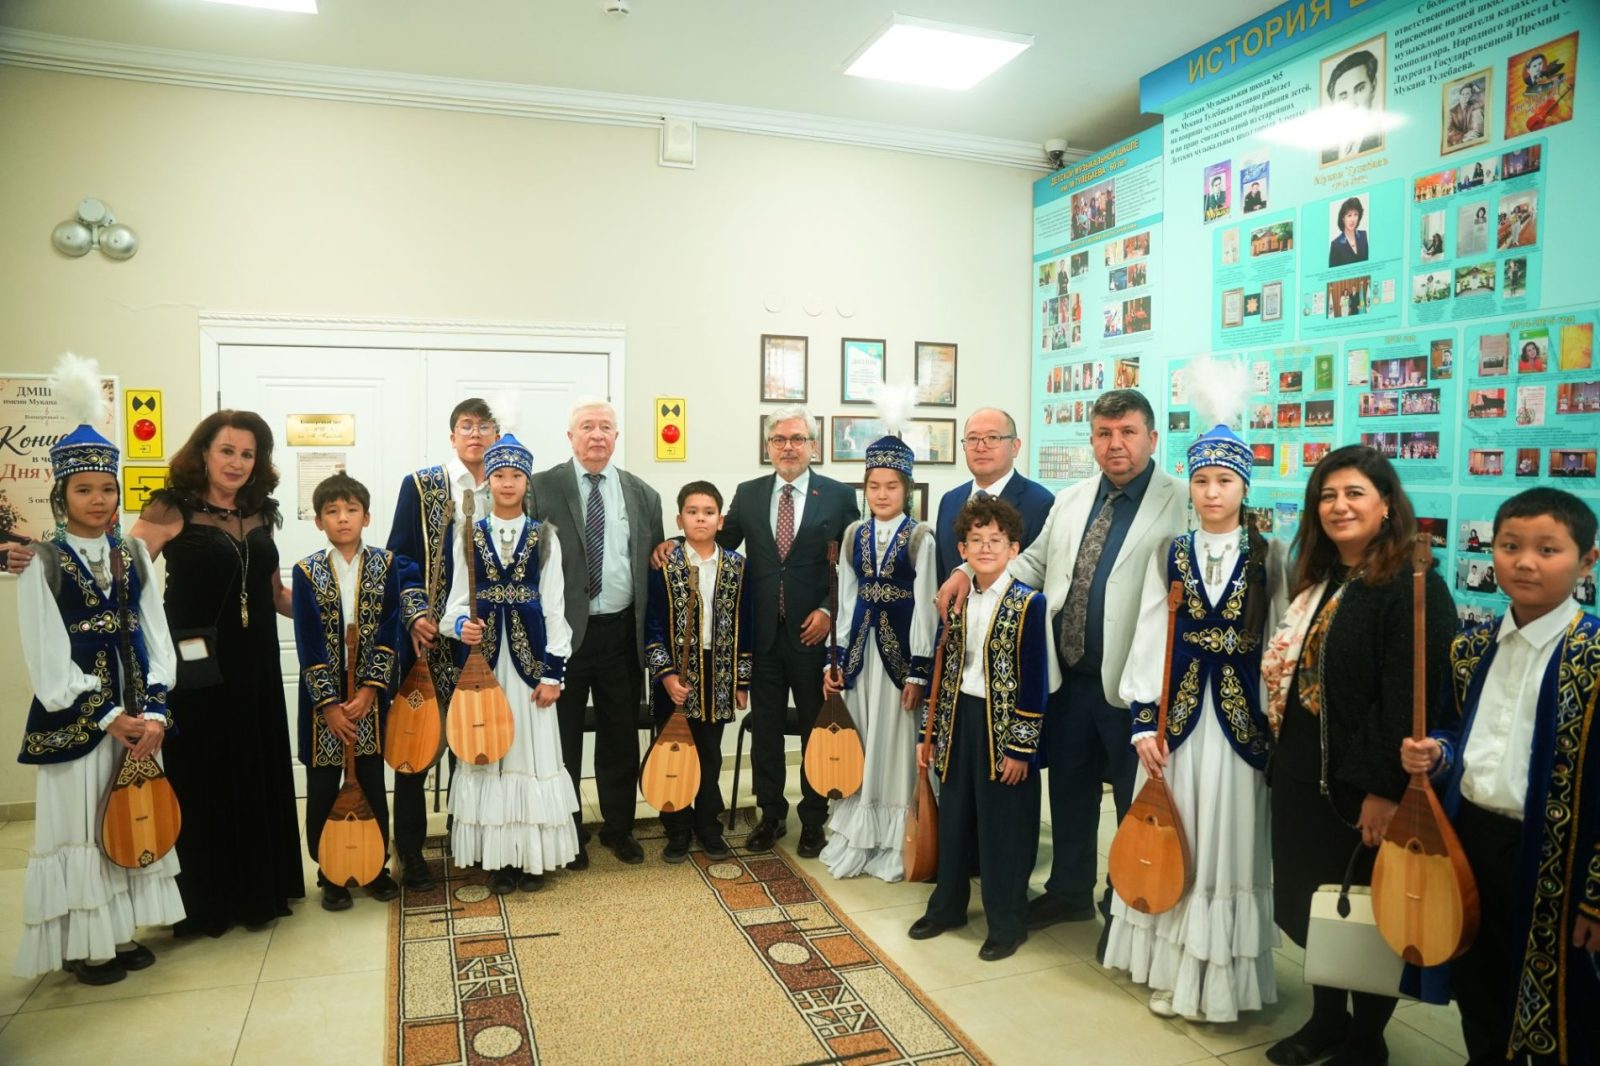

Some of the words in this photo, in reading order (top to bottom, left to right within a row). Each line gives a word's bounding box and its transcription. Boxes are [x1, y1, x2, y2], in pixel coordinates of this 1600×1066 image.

[1445, 7, 1475, 27] нашей
[1452, 22, 1504, 49] Народного
[1505, 4, 1549, 27] артиста
[1516, 12, 1560, 36] Премии
[1186, 0, 1332, 84] ИСТОРИЯ
[1394, 30, 1456, 60] музыкального
[1457, 13, 1495, 36] деятеля
[1393, 79, 1426, 96] Мукана
[0, 463, 40, 482] Дня
